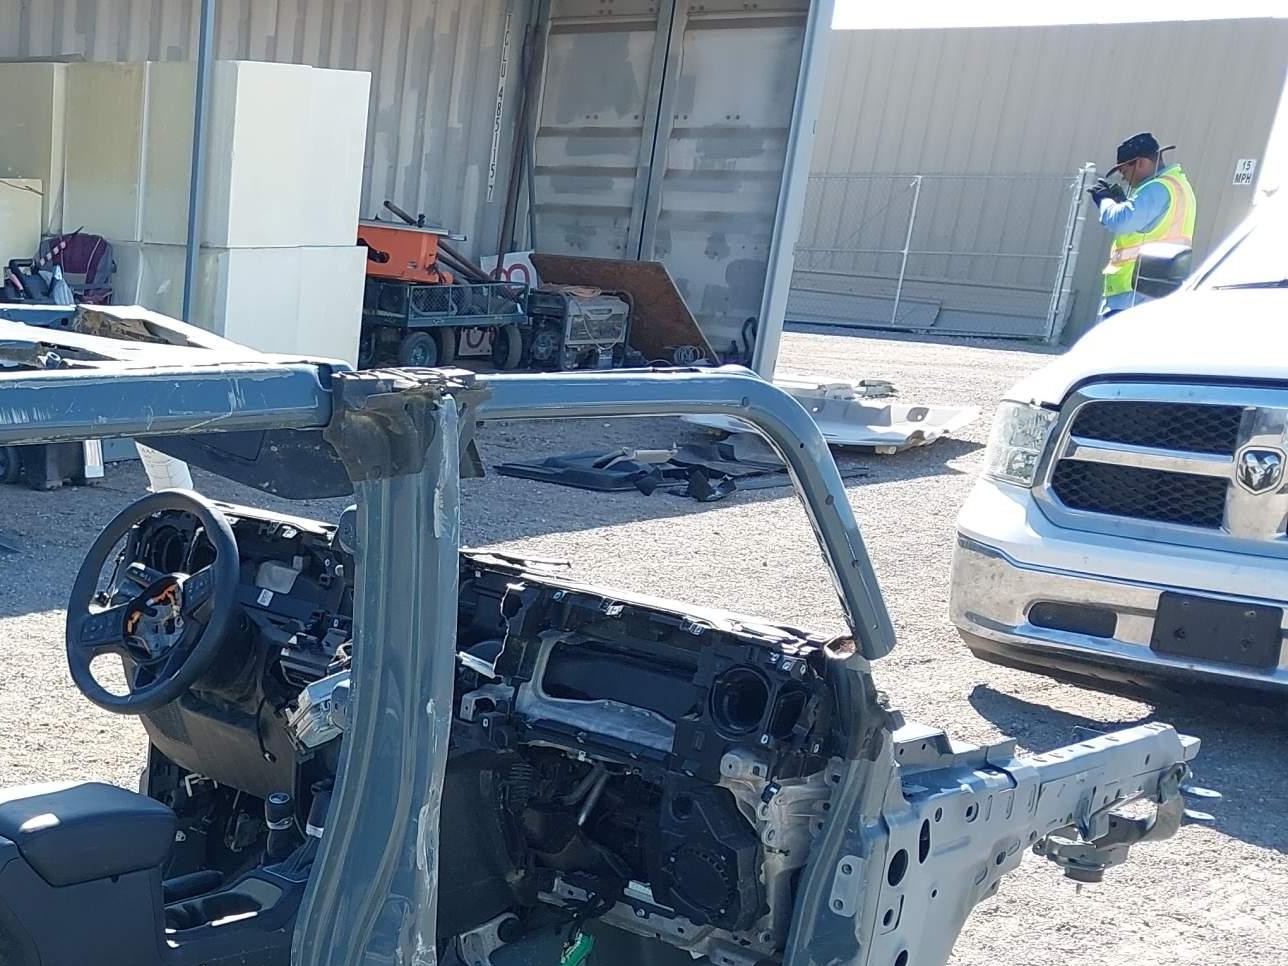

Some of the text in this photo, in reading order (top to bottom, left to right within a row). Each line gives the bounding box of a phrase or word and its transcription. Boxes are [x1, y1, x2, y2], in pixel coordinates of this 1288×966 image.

[489, 86, 504, 179] 485115
[1242, 160, 1252, 171] 15
[1234, 173, 1251, 183] MPH
